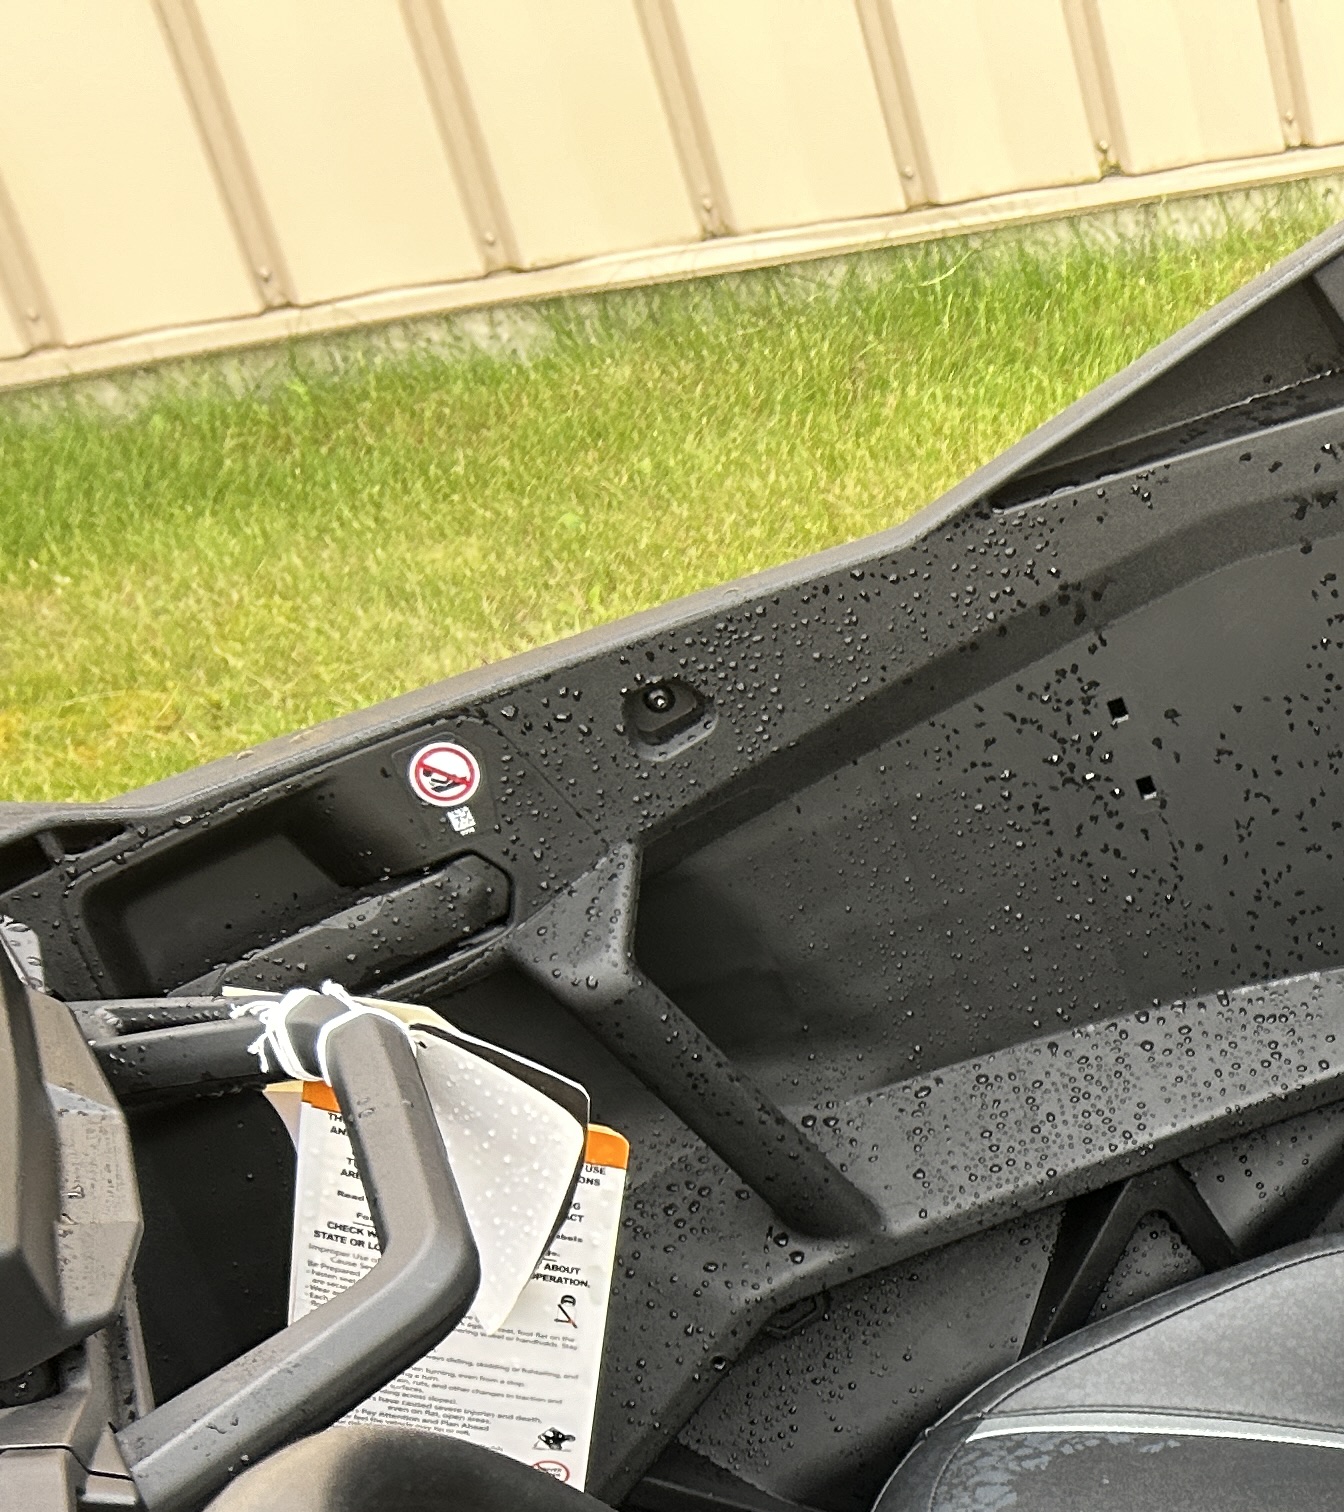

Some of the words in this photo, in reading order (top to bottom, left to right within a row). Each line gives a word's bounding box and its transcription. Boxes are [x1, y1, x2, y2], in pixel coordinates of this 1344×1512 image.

[337, 1190, 364, 1201] Read
[327, 1221, 364, 1236] CHECK
[313, 1230, 347, 1244] STATE
[350, 1238, 365, 1248] OR
[544, 1263, 581, 1275] ABOUT
